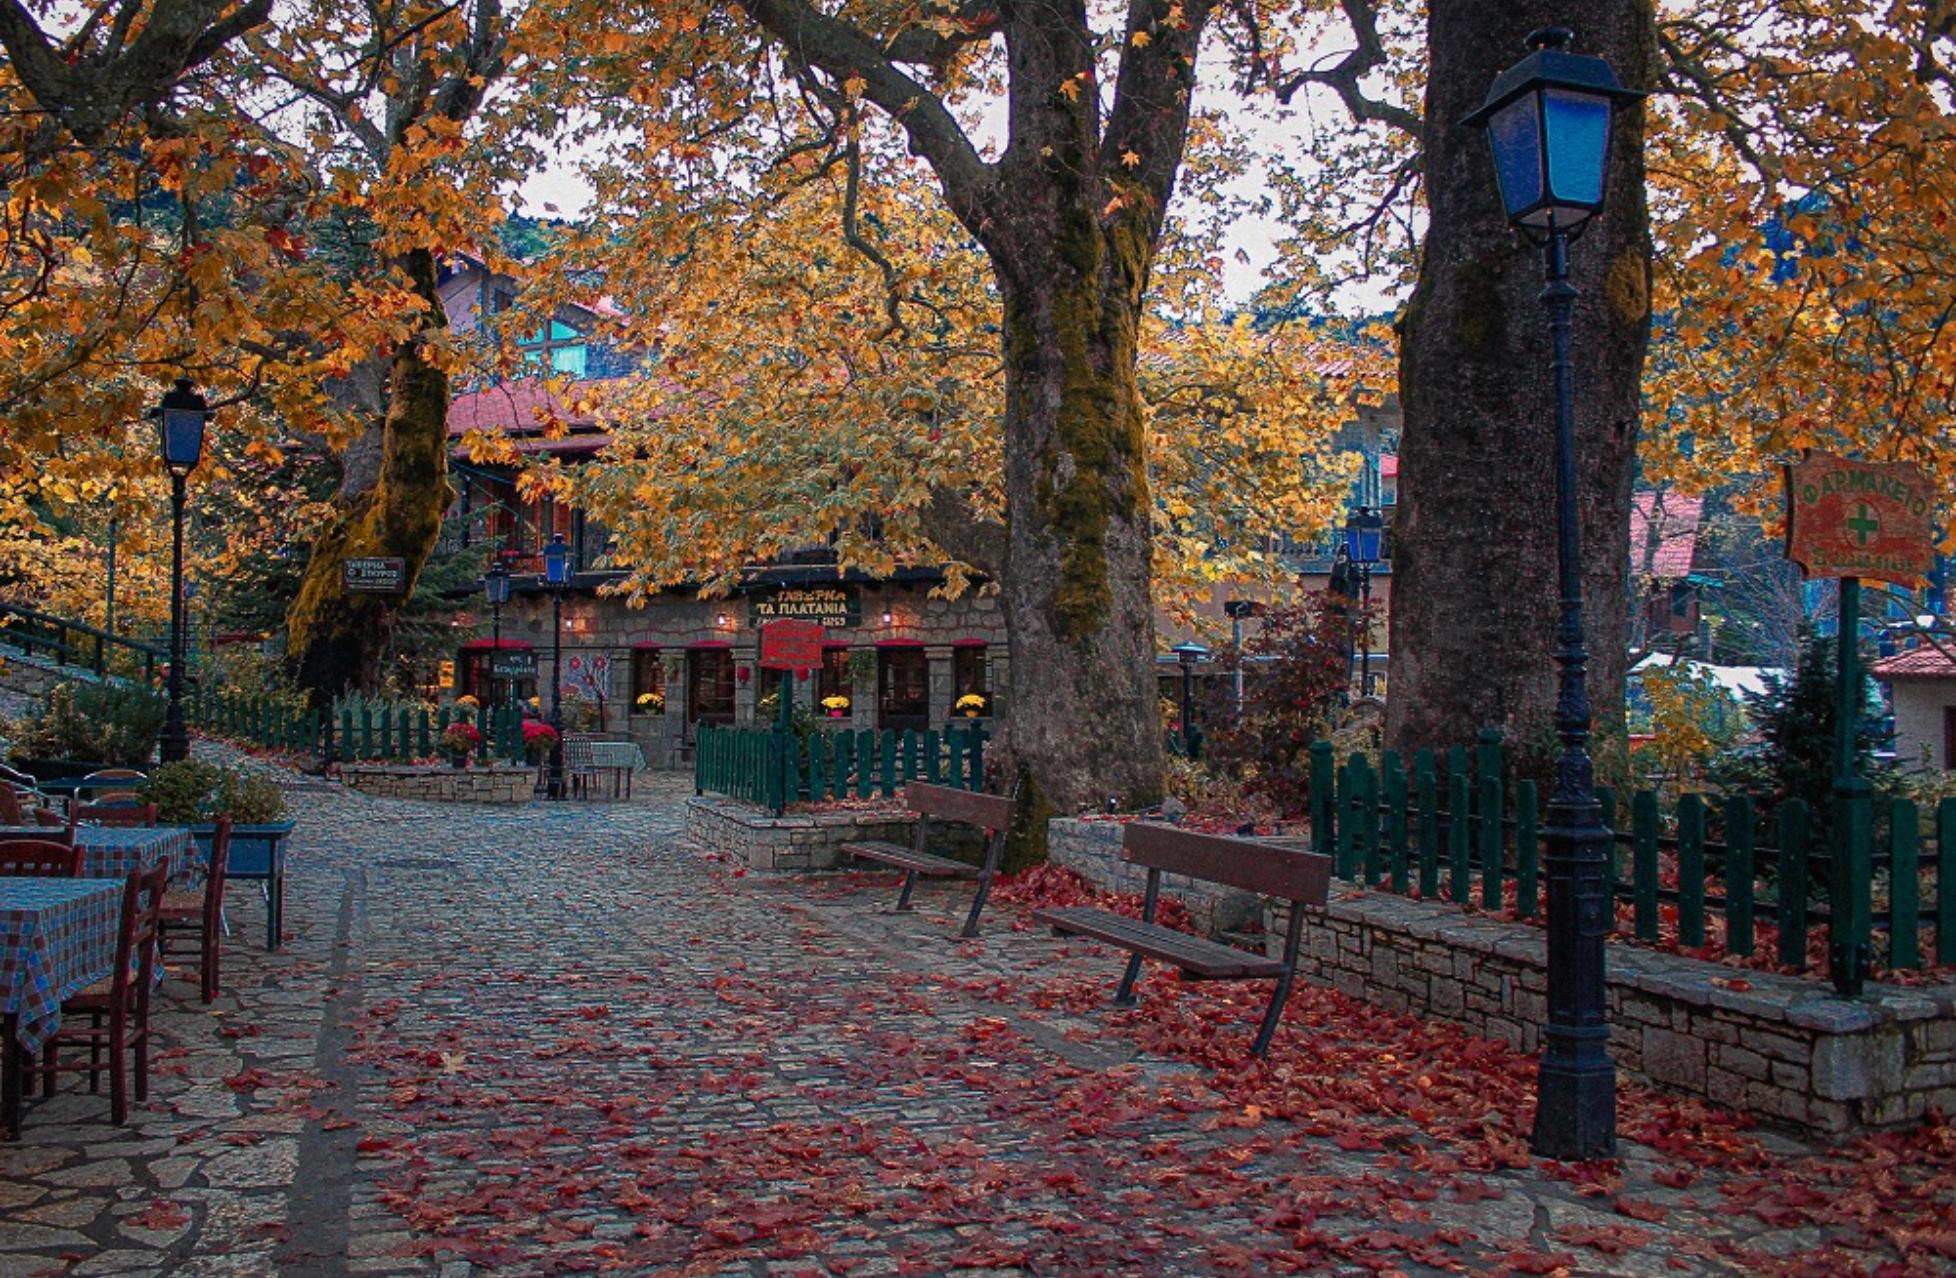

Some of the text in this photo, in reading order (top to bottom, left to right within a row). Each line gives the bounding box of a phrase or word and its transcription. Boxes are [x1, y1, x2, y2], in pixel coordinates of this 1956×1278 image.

[1803, 470, 1926, 516] ΦΑΡΜΑΚΕΙΟ
[756, 603, 847, 614] ΤΑ ΠΛΑΤΑΝΙΑ
